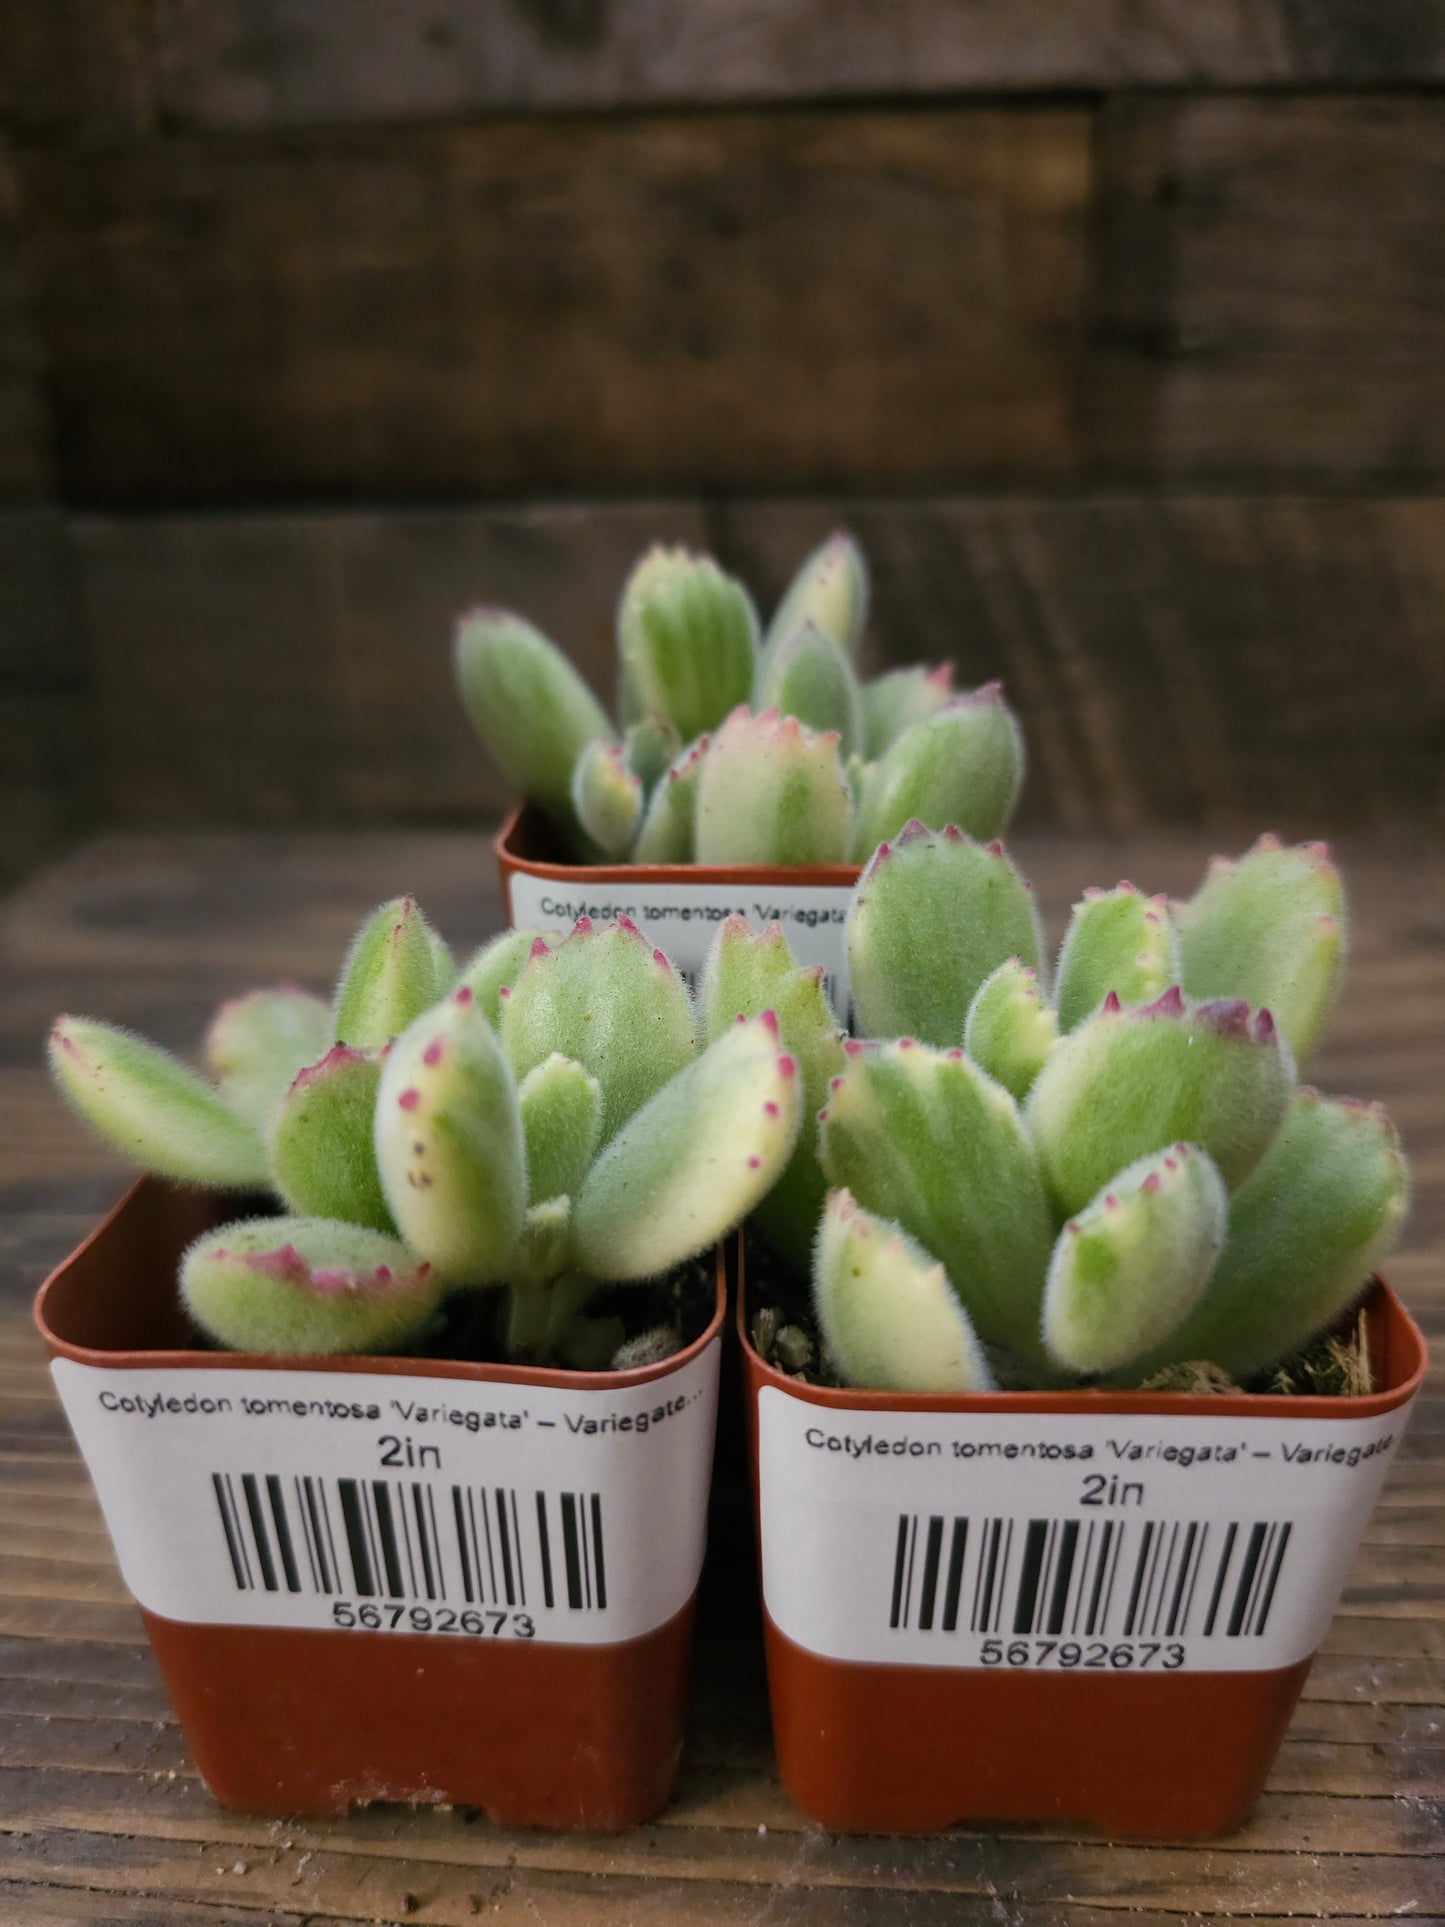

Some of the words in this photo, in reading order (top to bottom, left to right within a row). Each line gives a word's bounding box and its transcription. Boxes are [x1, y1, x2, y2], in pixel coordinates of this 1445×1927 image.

[99, 1391, 232, 1418] Cotyledon
[241, 1397, 381, 1419] tomentosa
[389, 1400, 529, 1432] 'Variegata'
[377, 1435, 441, 1469] 2in
[805, 1428, 942, 1458] Cotyledon
[951, 1440, 1094, 1460] tomentosa
[1105, 1440, 1247, 1467] 'Variegata'
[1080, 1473, 1145, 1506] 2in
[332, 1601, 536, 1638] 56792673
[980, 1639, 1185, 1668] 56792673
